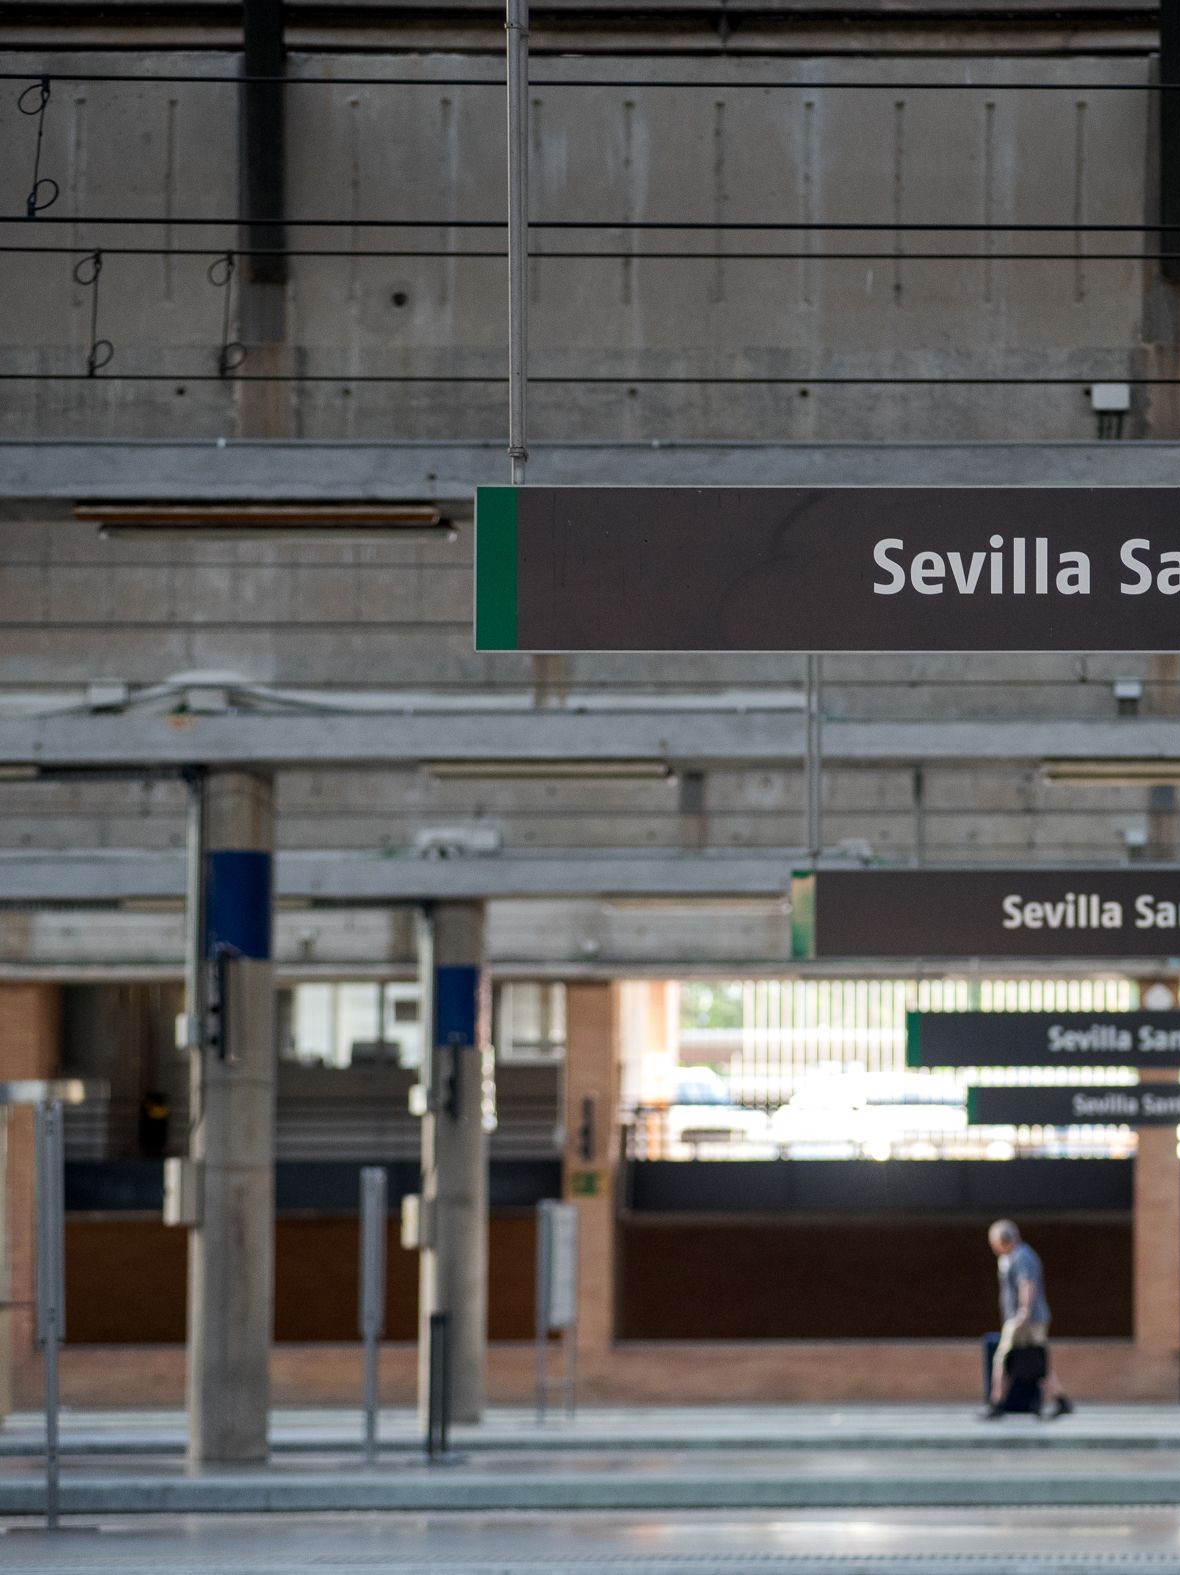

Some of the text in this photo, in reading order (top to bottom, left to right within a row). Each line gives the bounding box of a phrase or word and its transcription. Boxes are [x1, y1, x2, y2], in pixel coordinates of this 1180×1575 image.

[873, 535, 1091, 595] Sevilla
[1002, 893, 1123, 929] Sevilla
[1048, 1025, 1132, 1051] Sevilla
[1073, 1094, 1138, 1115] Sevilla
